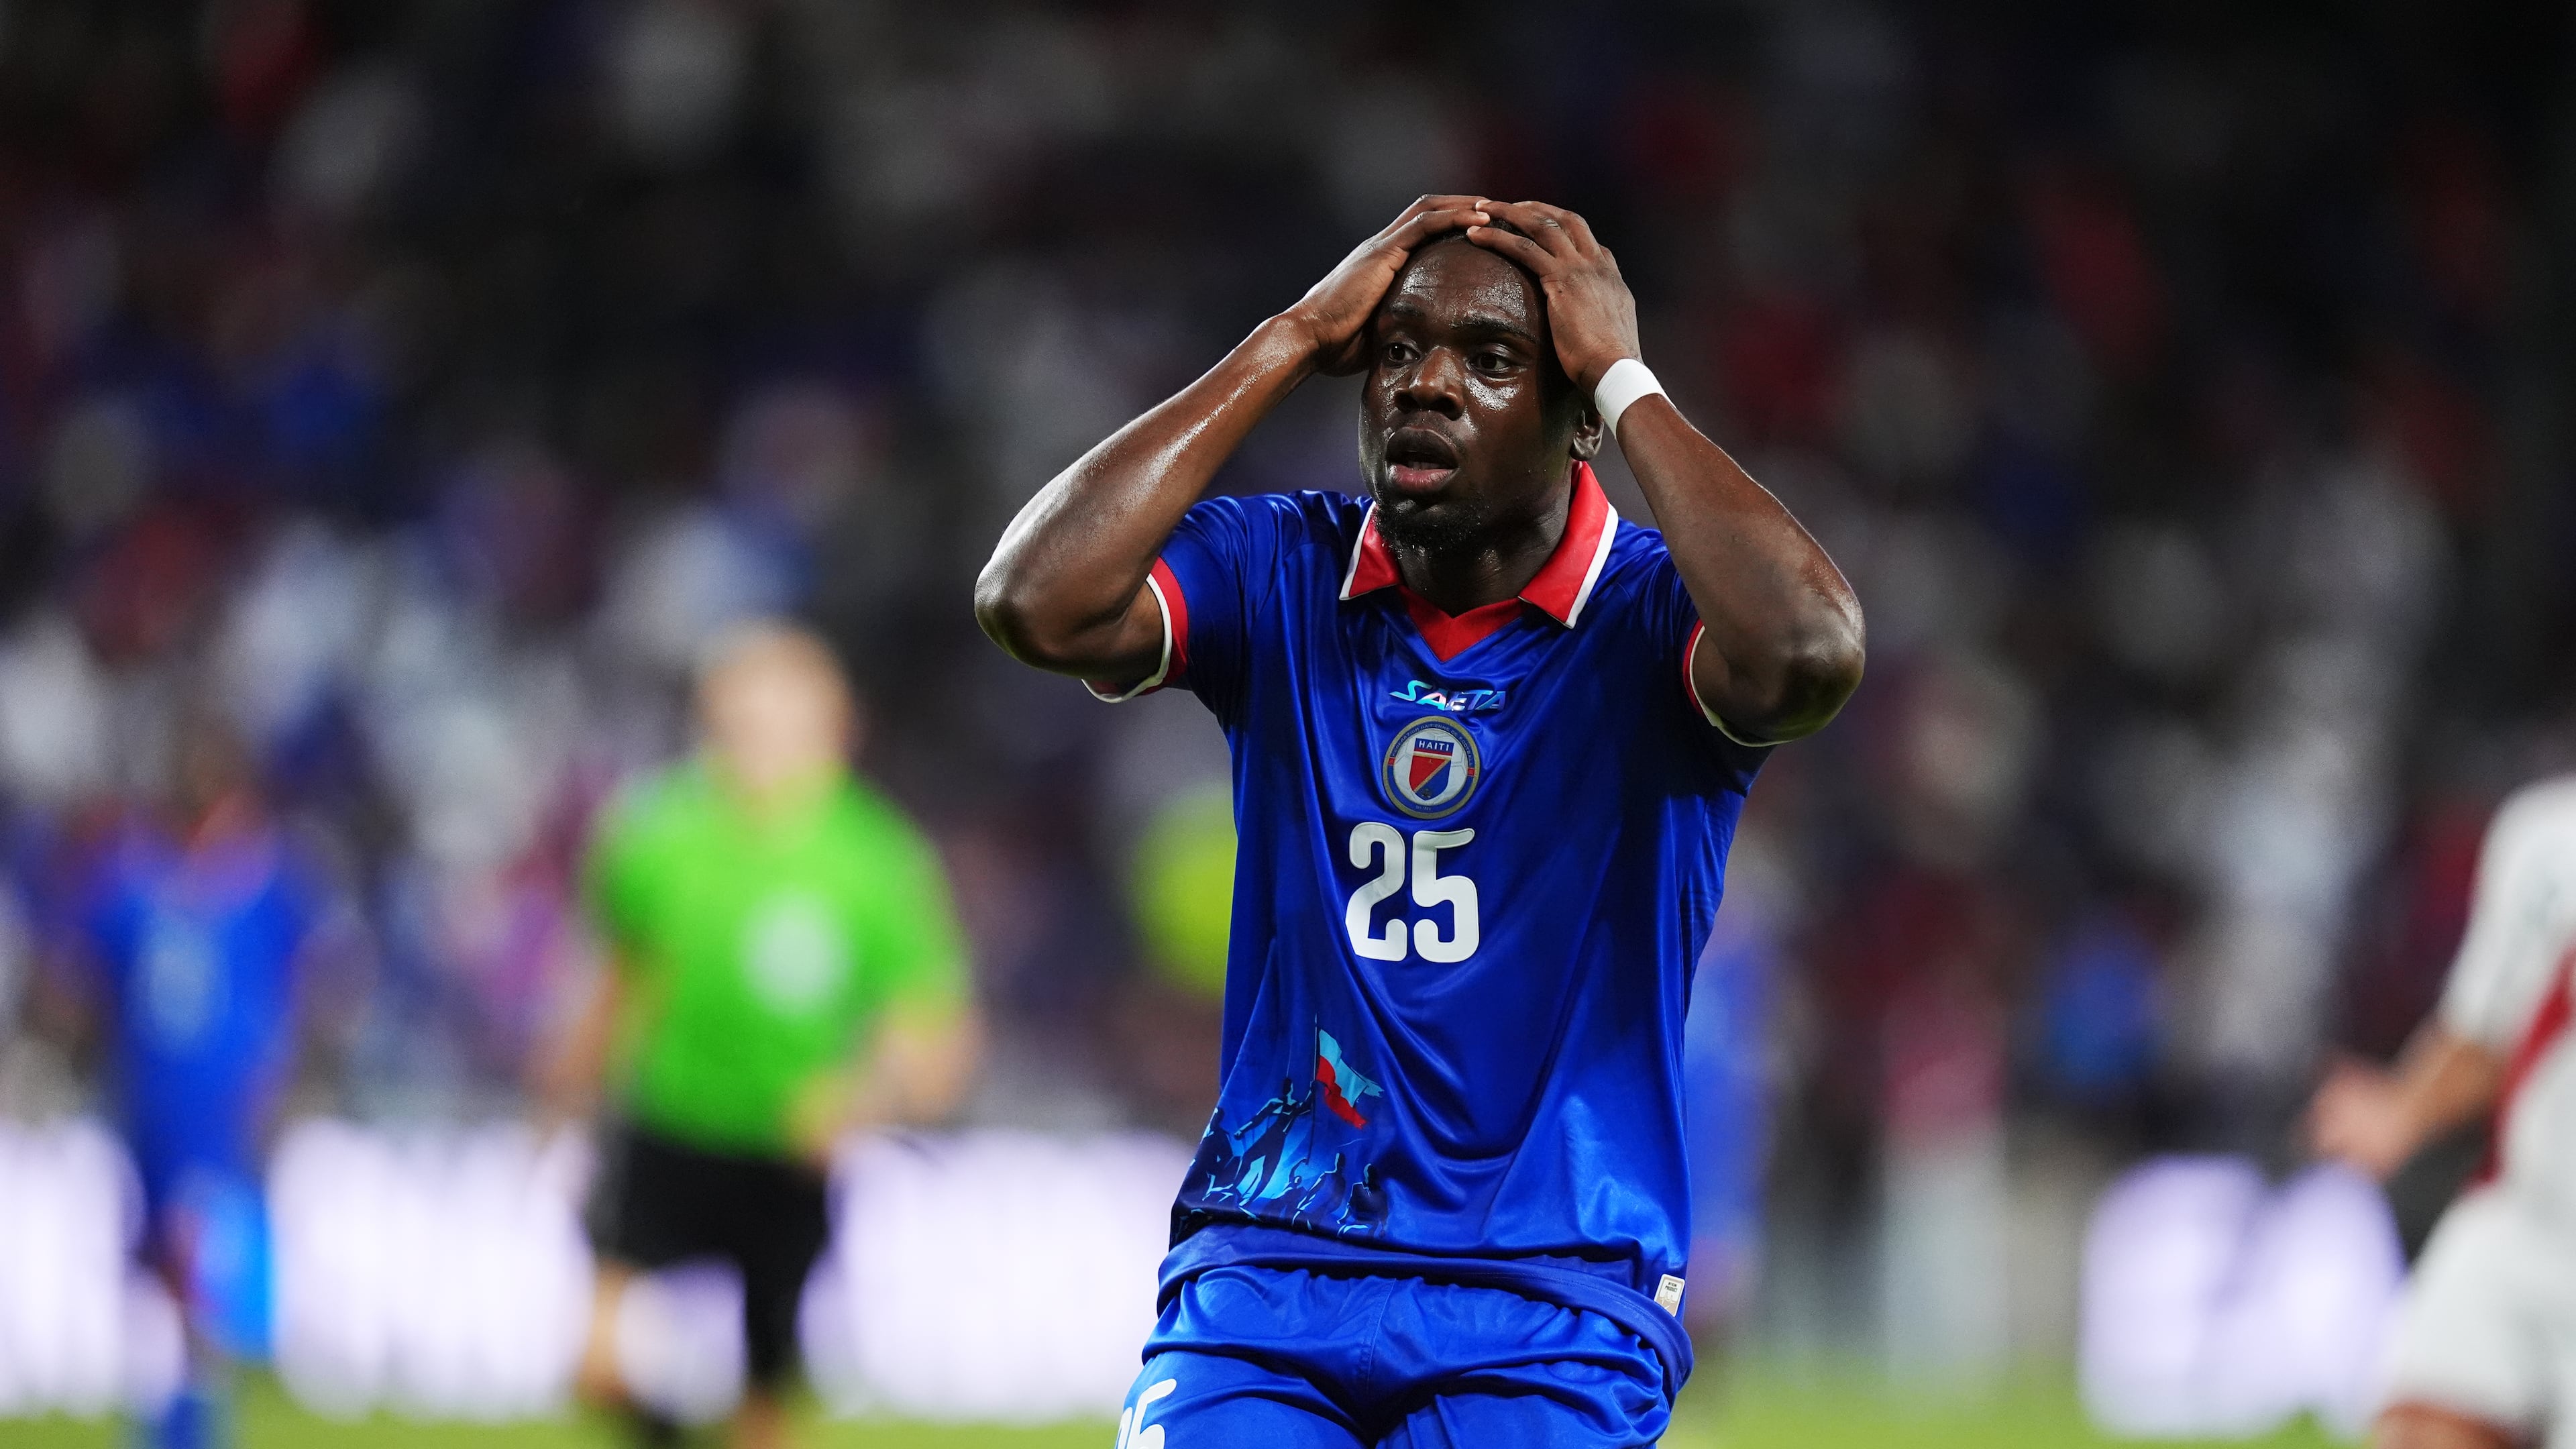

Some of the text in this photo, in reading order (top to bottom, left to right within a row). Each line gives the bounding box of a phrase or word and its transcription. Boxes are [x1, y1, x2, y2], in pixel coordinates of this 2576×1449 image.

[1389, 680, 1506, 711] SAETA
[1419, 740, 1449, 752] HAITI
[1345, 822, 1480, 963] 25
